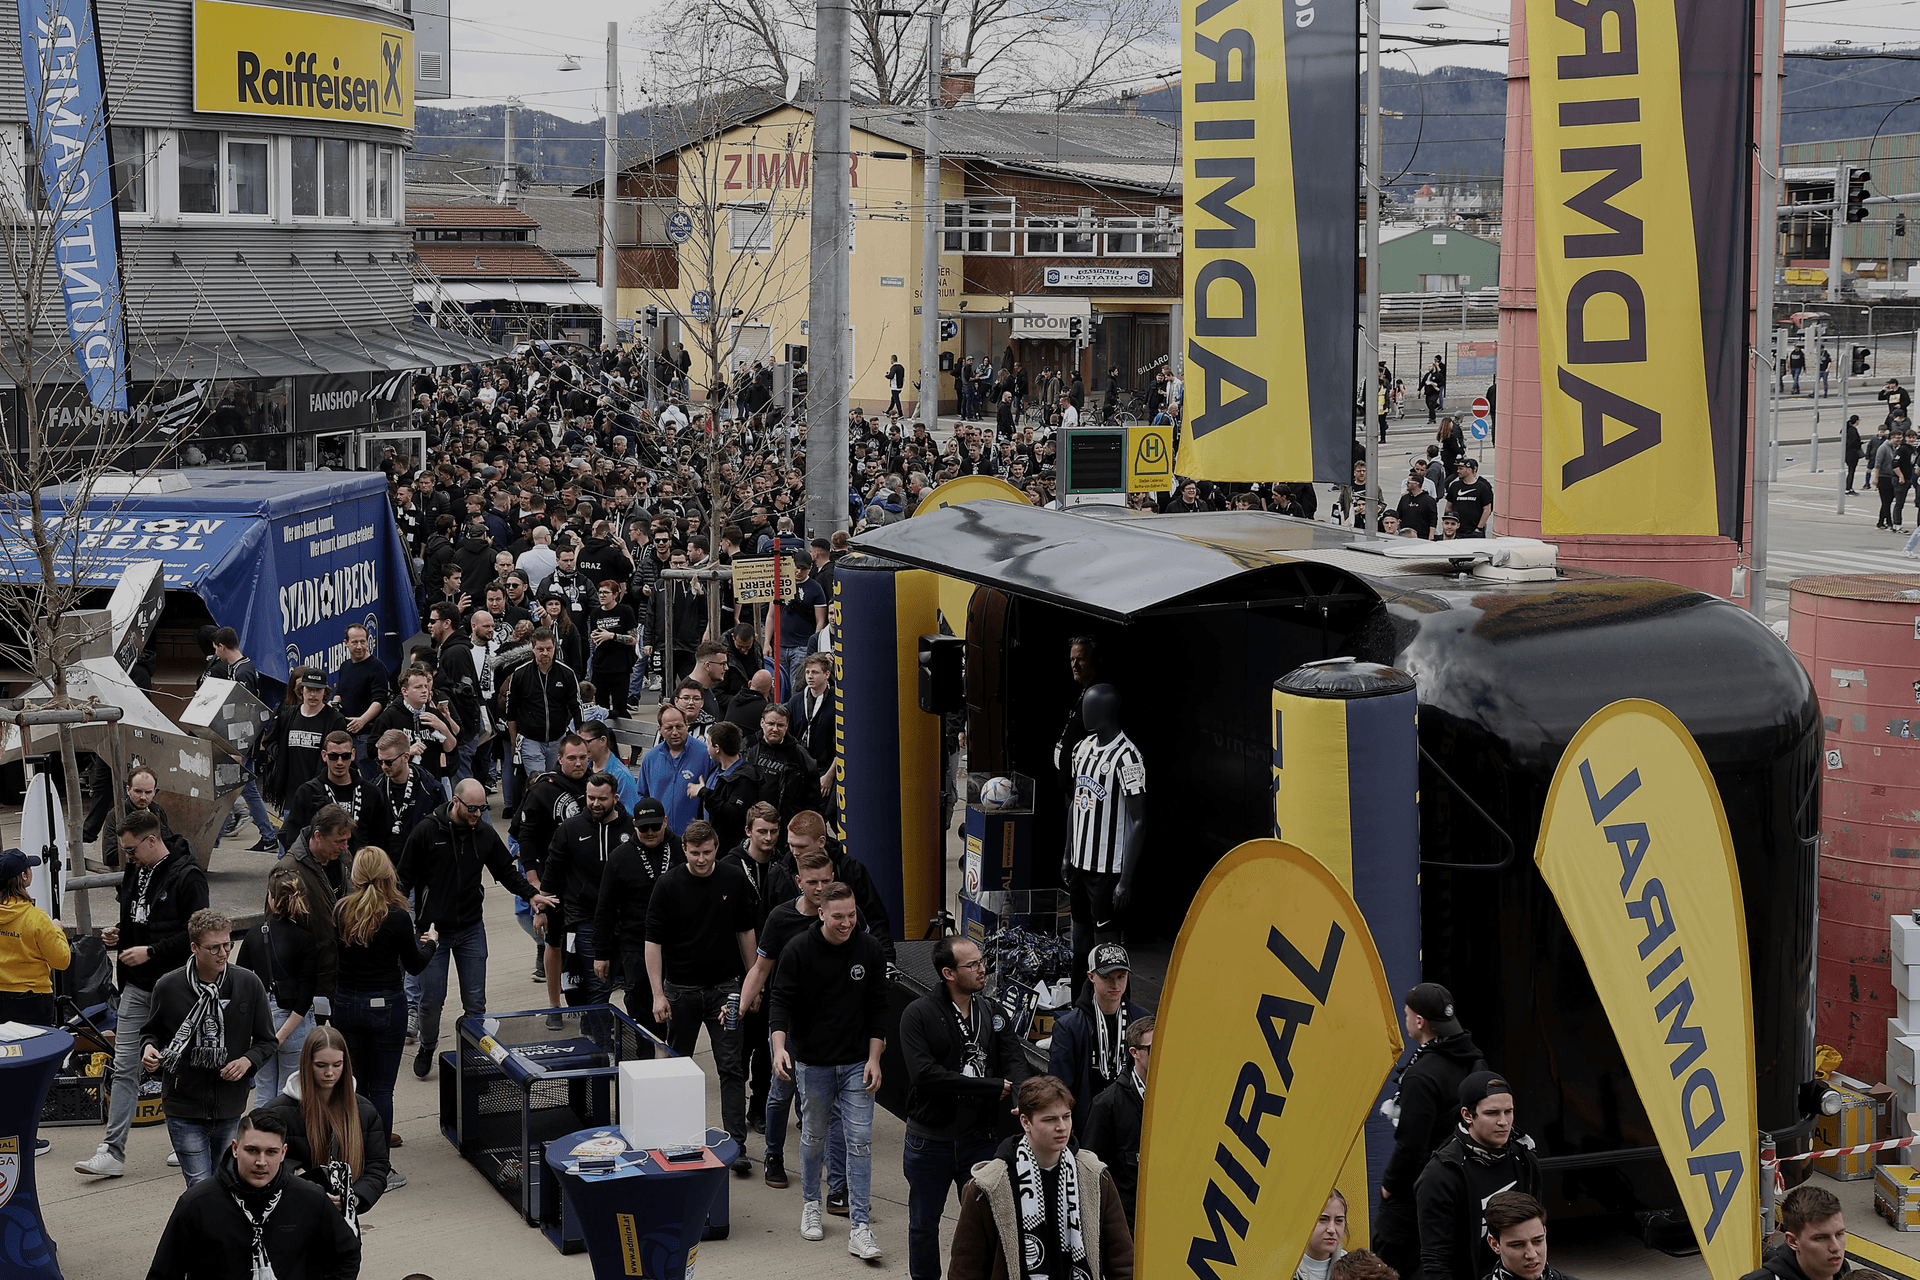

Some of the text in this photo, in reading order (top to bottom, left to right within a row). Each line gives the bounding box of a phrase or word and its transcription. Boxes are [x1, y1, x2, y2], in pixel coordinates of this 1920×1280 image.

[237, 50, 380, 113] Raiffeisen
[724, 152, 859, 190] ZIMMR
[914, 289, 955, 298] SRIUM
[1137, 354, 1169, 375] BILLARD
[309, 390, 359, 412] FANSHOP
[1075, 496, 1081, 504] 4
[79, 534, 208, 551] BEISL
[283, 525, 294, 543] Wer
[310, 540, 320, 558] Wer
[580, 561, 602, 570] GRAZ
[738, 578, 792, 590] GESPERRT
[622, 1215, 638, 1274] www.admiral.at
